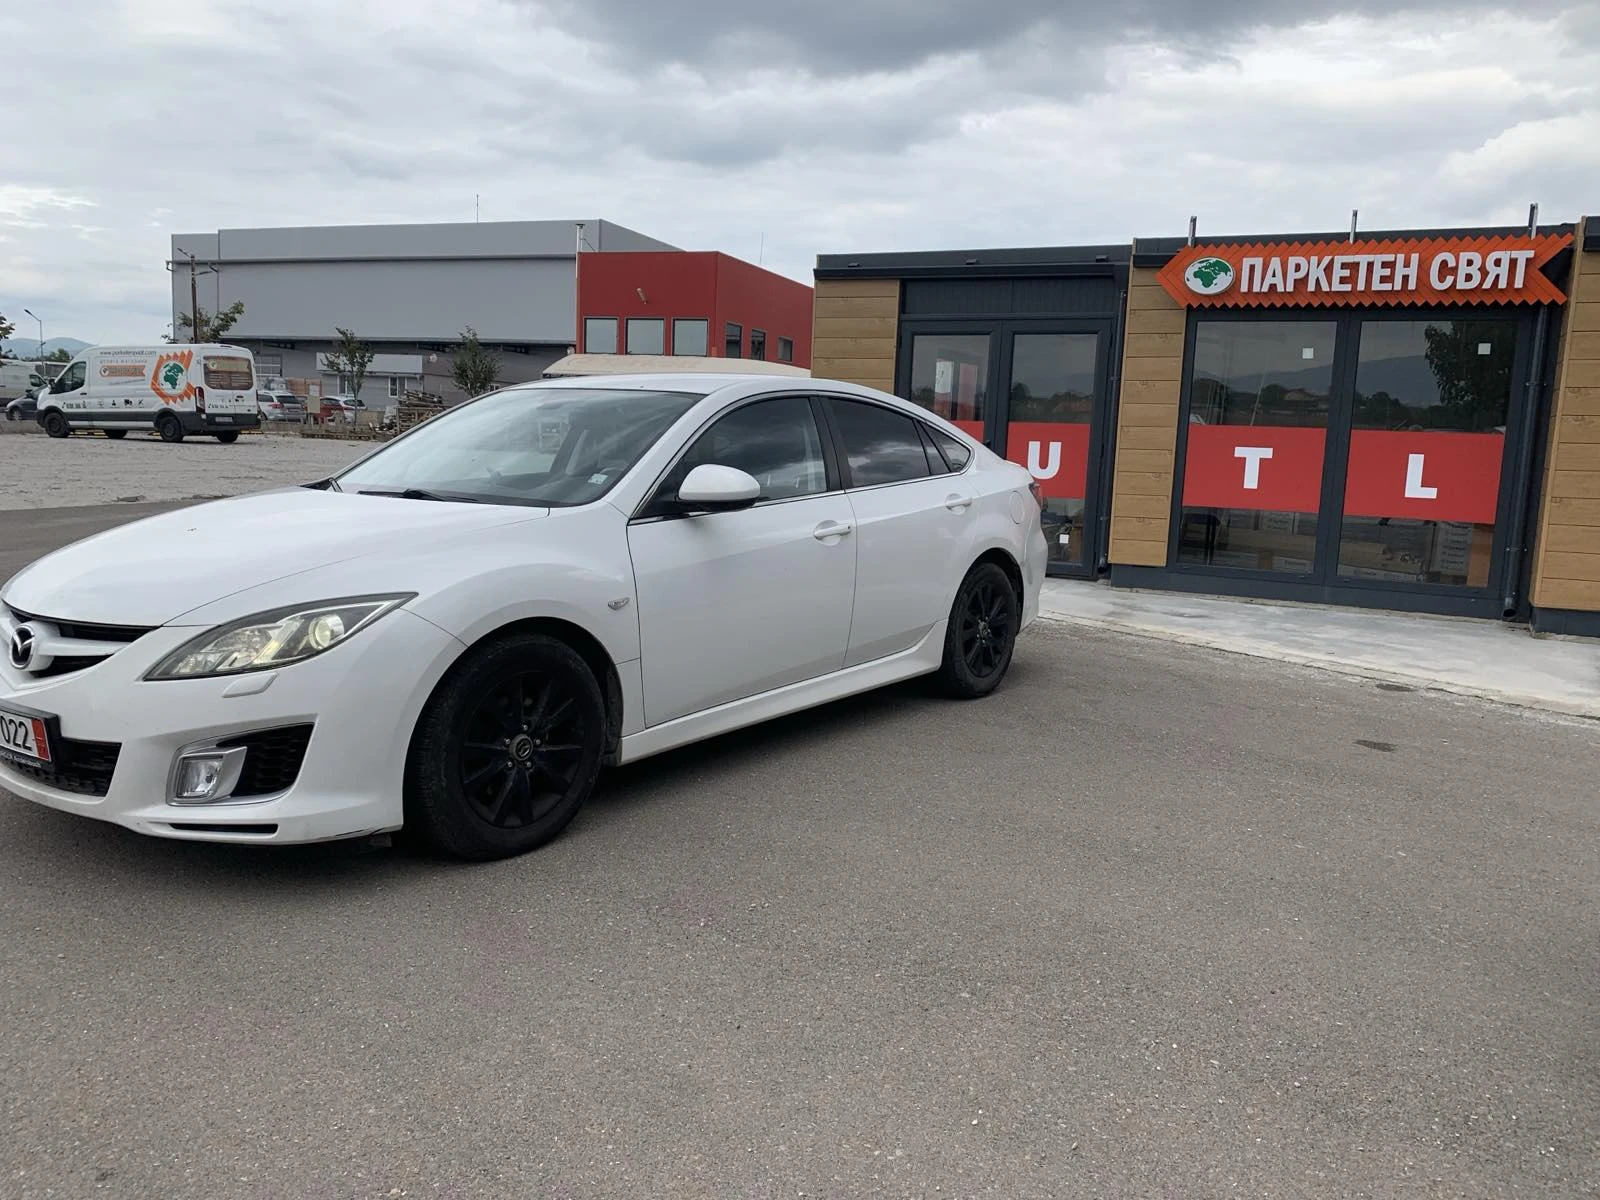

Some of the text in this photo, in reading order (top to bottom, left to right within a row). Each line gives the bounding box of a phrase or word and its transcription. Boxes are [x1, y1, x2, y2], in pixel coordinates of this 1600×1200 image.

[1240, 250, 1535, 293] ПАРКЕТЕН СВЯТ
[1028, 441, 1438, 499] U T L
[0, 715, 33, 752] 022
